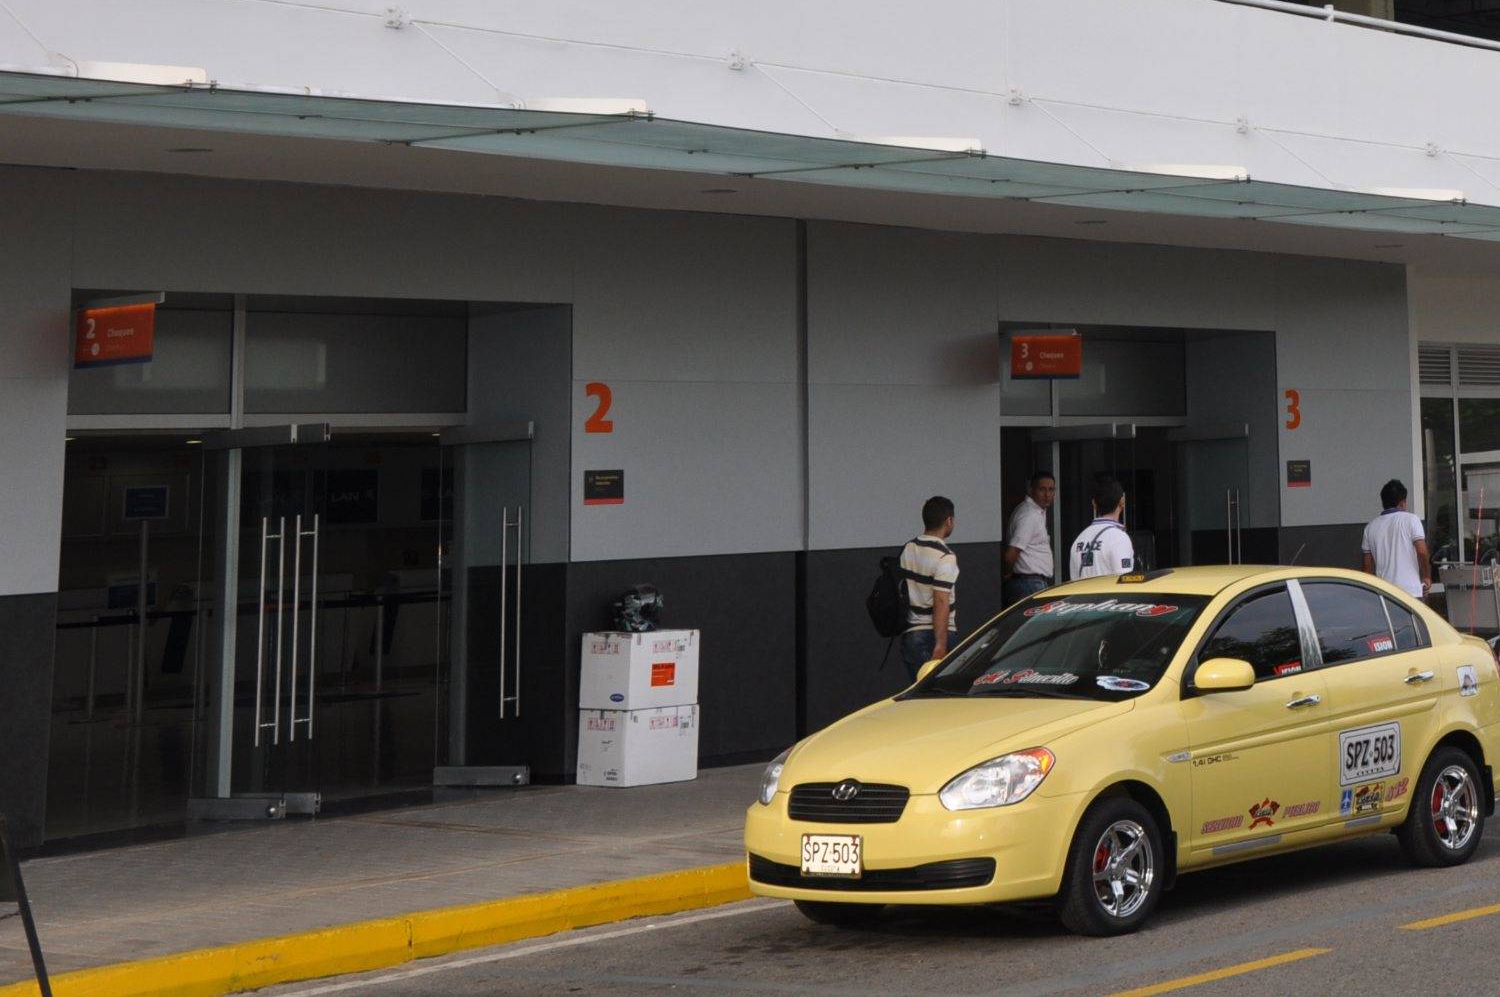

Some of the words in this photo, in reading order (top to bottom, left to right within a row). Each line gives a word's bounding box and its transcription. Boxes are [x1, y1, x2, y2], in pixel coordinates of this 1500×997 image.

[86, 318, 96, 339] 2
[1021, 343, 1029, 358] 3
[585, 382, 613, 433] 2
[1285, 390, 1300, 430] 3
